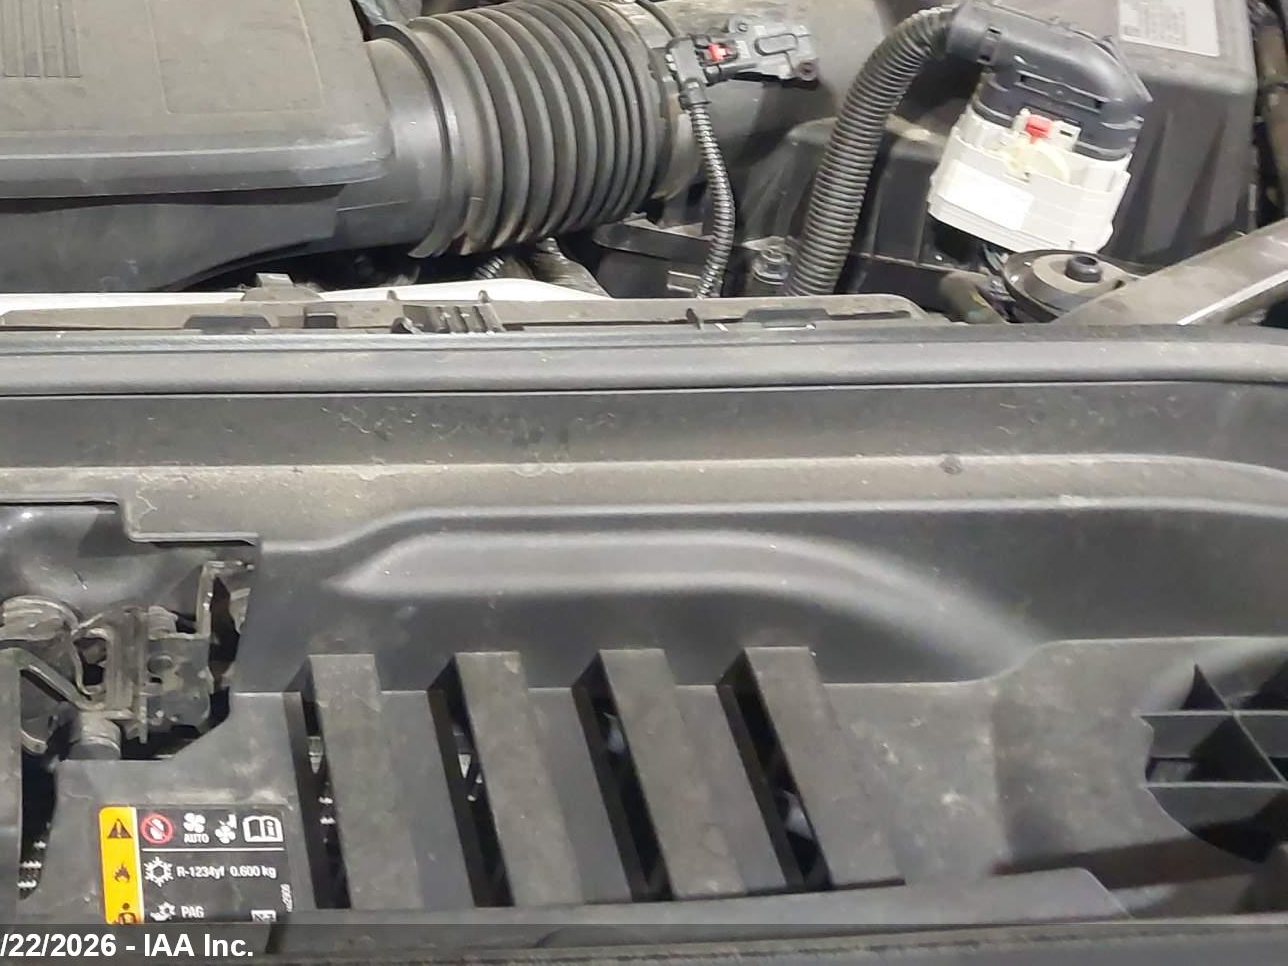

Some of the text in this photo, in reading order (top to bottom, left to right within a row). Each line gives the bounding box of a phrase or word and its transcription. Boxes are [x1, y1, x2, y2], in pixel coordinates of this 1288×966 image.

[183, 833, 210, 844] AUTO
[176, 865, 278, 880] R-1234yf 0.600 kg
[180, 905, 205, 919] PAG
